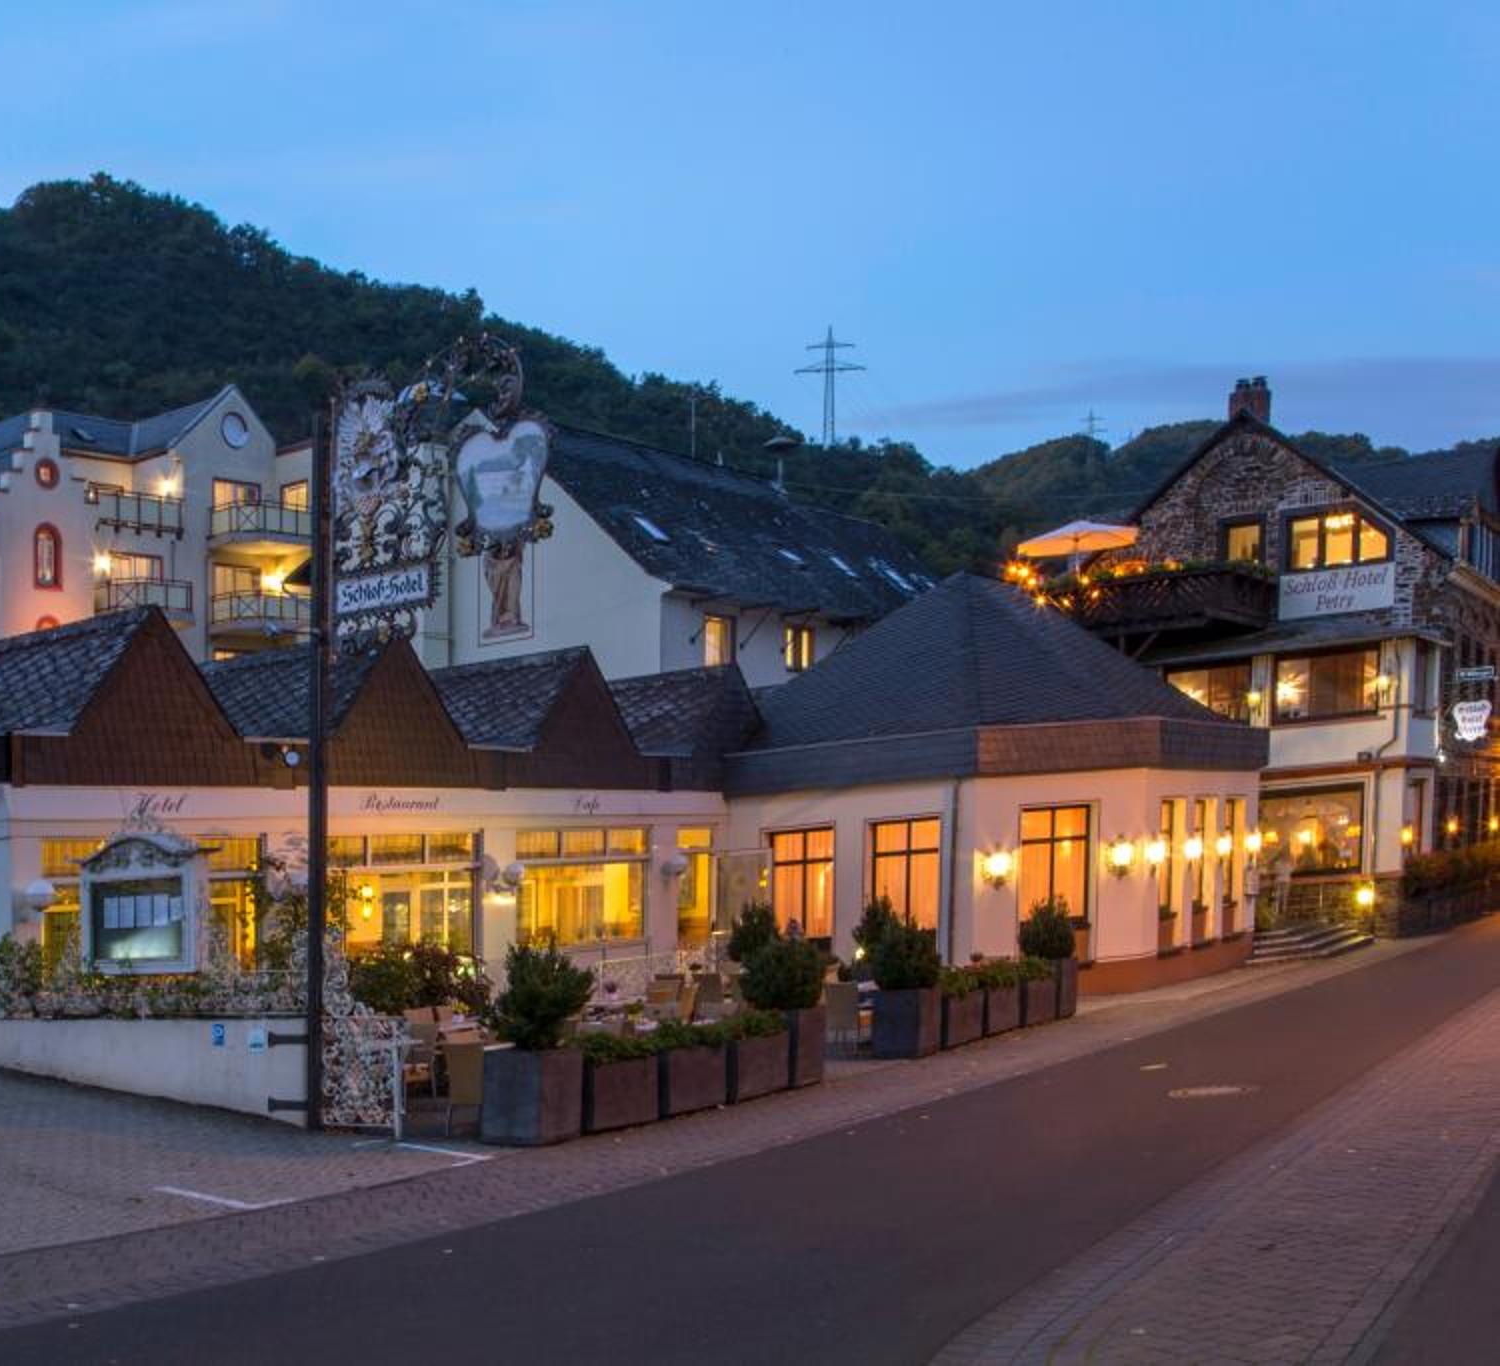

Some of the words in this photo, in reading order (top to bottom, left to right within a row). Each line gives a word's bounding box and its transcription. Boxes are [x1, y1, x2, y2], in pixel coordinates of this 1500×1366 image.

[1344, 565, 1388, 590] Hotel
[134, 792, 187, 815] Hotel
[362, 792, 440, 812] Restaurant
